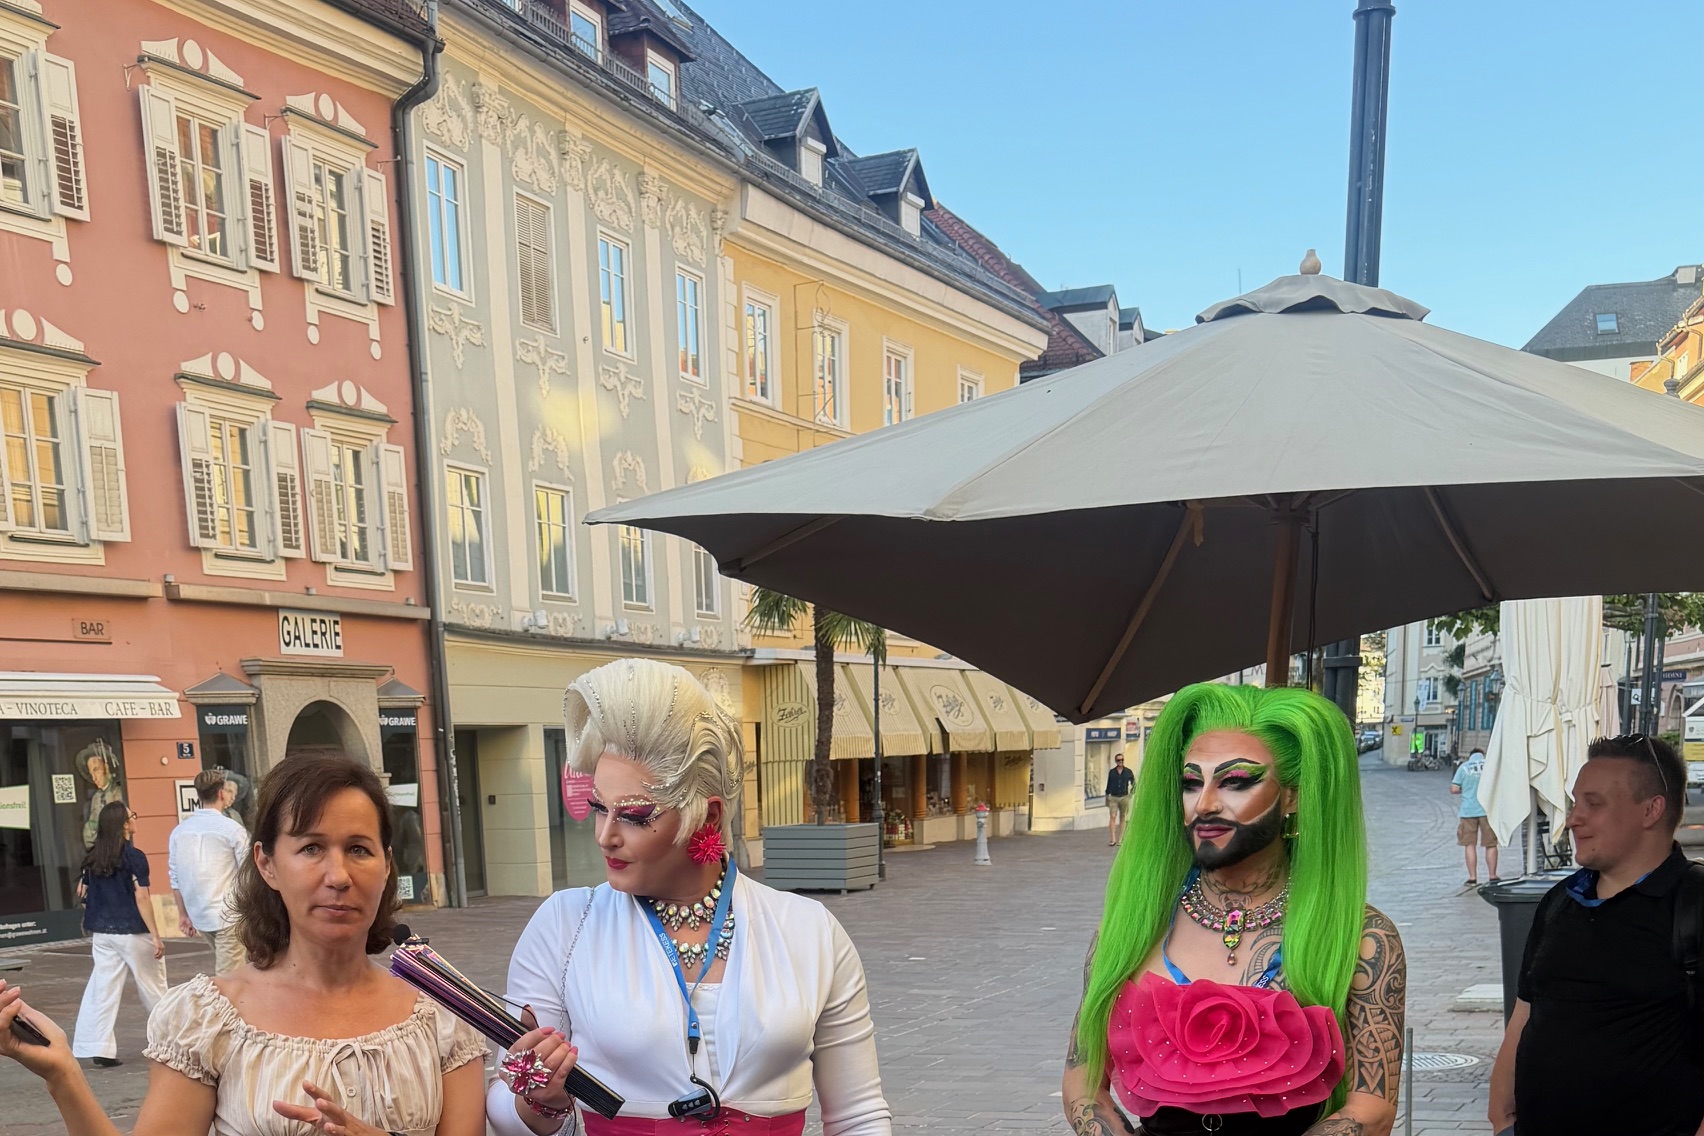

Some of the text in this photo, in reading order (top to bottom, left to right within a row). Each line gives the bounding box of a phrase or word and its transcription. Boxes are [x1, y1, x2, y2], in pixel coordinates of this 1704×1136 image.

[80, 621, 104, 636] BAR
[281, 615, 342, 650] GALERIE
[16, 702, 78, 716] VINOTECA
[150, 701, 174, 716] BAR
[216, 714, 248, 726] GRAWE
[388, 717, 416, 727] GRAWE
[183, 743, 190, 754] 5
